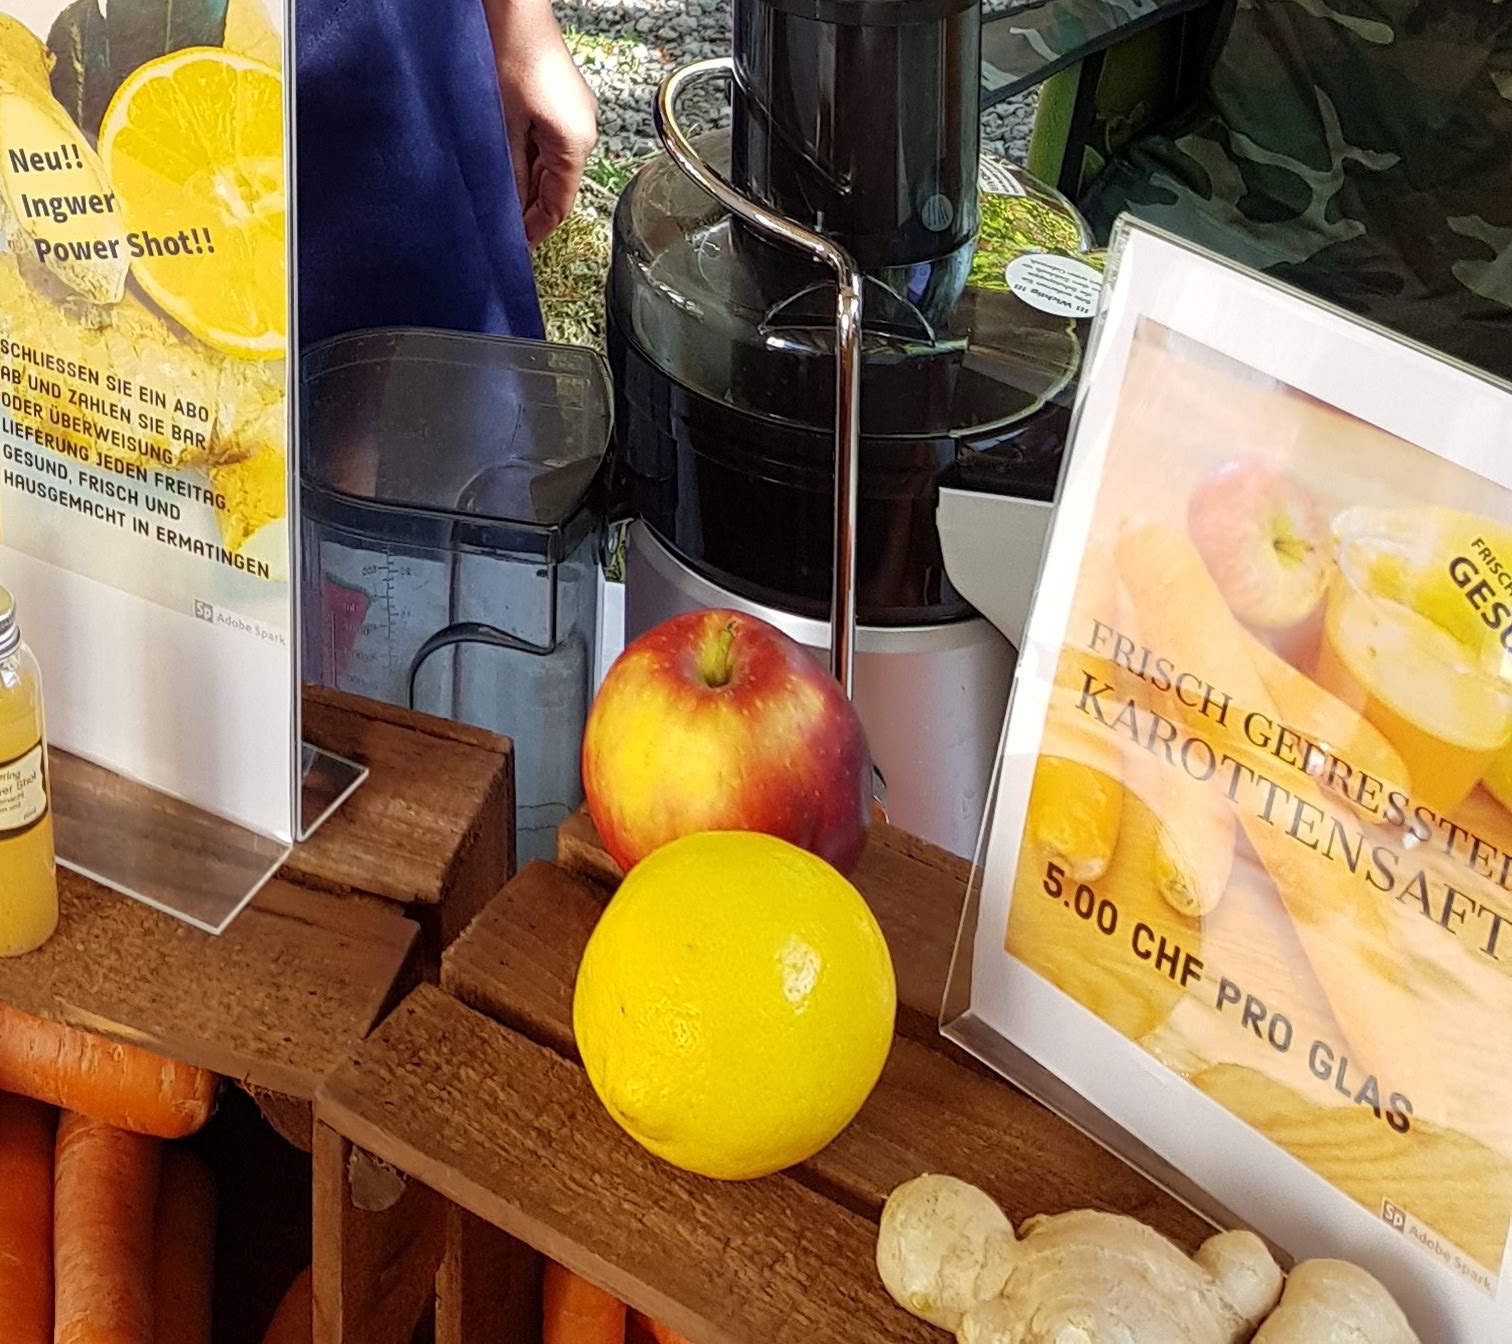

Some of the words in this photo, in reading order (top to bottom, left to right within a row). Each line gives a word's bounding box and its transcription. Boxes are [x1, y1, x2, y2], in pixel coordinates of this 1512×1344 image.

[9, 144, 83, 173] Neu!!
[22, 193, 115, 223] Ingwer
[35, 238, 119, 262] Power
[127, 228, 214, 258] Shot!!
[0, 339, 99, 386] SCHLIESSEN
[106, 375, 132, 398] SIE
[139, 386, 165, 409] EIN
[174, 398, 208, 422] ABO
[1, 366, 21, 385] AB
[28, 375, 61, 399] UND
[68, 389, 131, 424] ZAHLEN
[139, 414, 164, 435] SIE
[172, 425, 206, 450] BAR
[1, 392, 43, 419] ODER
[50, 404, 173, 465] ÜBERWEISUNG
[3, 418, 88, 461] LIEFERUNG
[96, 446, 147, 483] JEDEN
[155, 472, 231, 513] FREITAG.
[3, 444, 72, 485] GESUND,
[79, 472, 138, 506] FRISCH
[145, 495, 180, 520] UND
[4, 470, 125, 527] HAUSGEMACHT
[133, 517, 149, 537] IN
[157, 529, 269, 579] ERMATINGEN
[195, 600, 213, 623] Sp
[217, 612, 251, 635] Adobe
[255, 625, 285, 646] Spark
[1088, 619, 1233, 728] FRISCH
[1075, 669, 1512, 961] KAROTTENSAFT
[1042, 861, 1118, 936] 5.00
[1131, 921, 1204, 988] CHF
[1215, 983, 1293, 1054] PRO
[1307, 1039, 1414, 1135] GLAS
